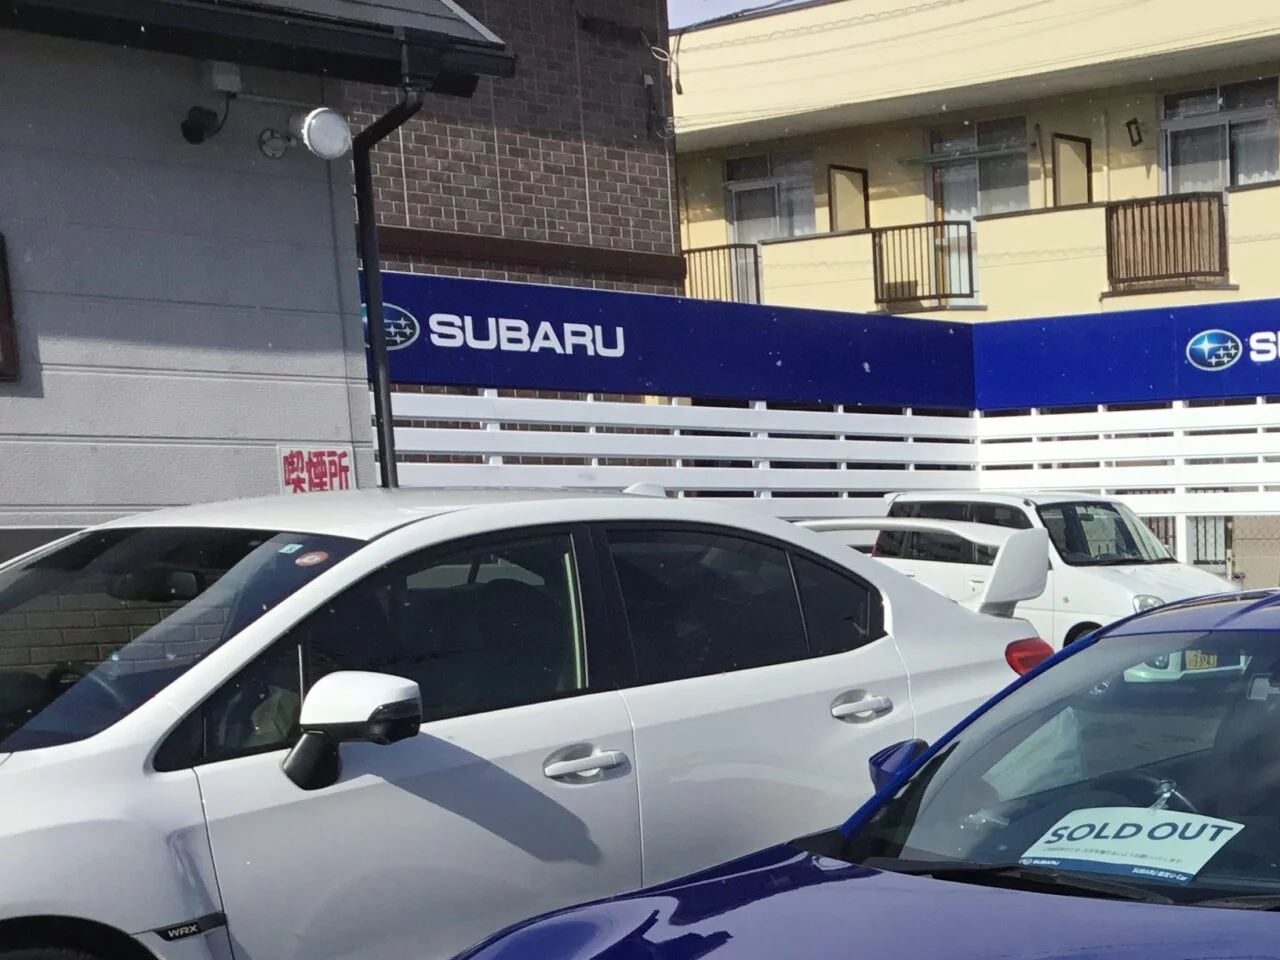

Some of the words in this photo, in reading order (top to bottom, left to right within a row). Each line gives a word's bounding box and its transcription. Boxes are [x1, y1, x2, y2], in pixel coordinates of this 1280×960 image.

[428, 313, 625, 358] SUBARU
[283, 449, 350, 494] 喫煙所
[1044, 822, 1143, 845] SOLD
[1147, 821, 1234, 842] OUT
[167, 924, 198, 938] WRX
